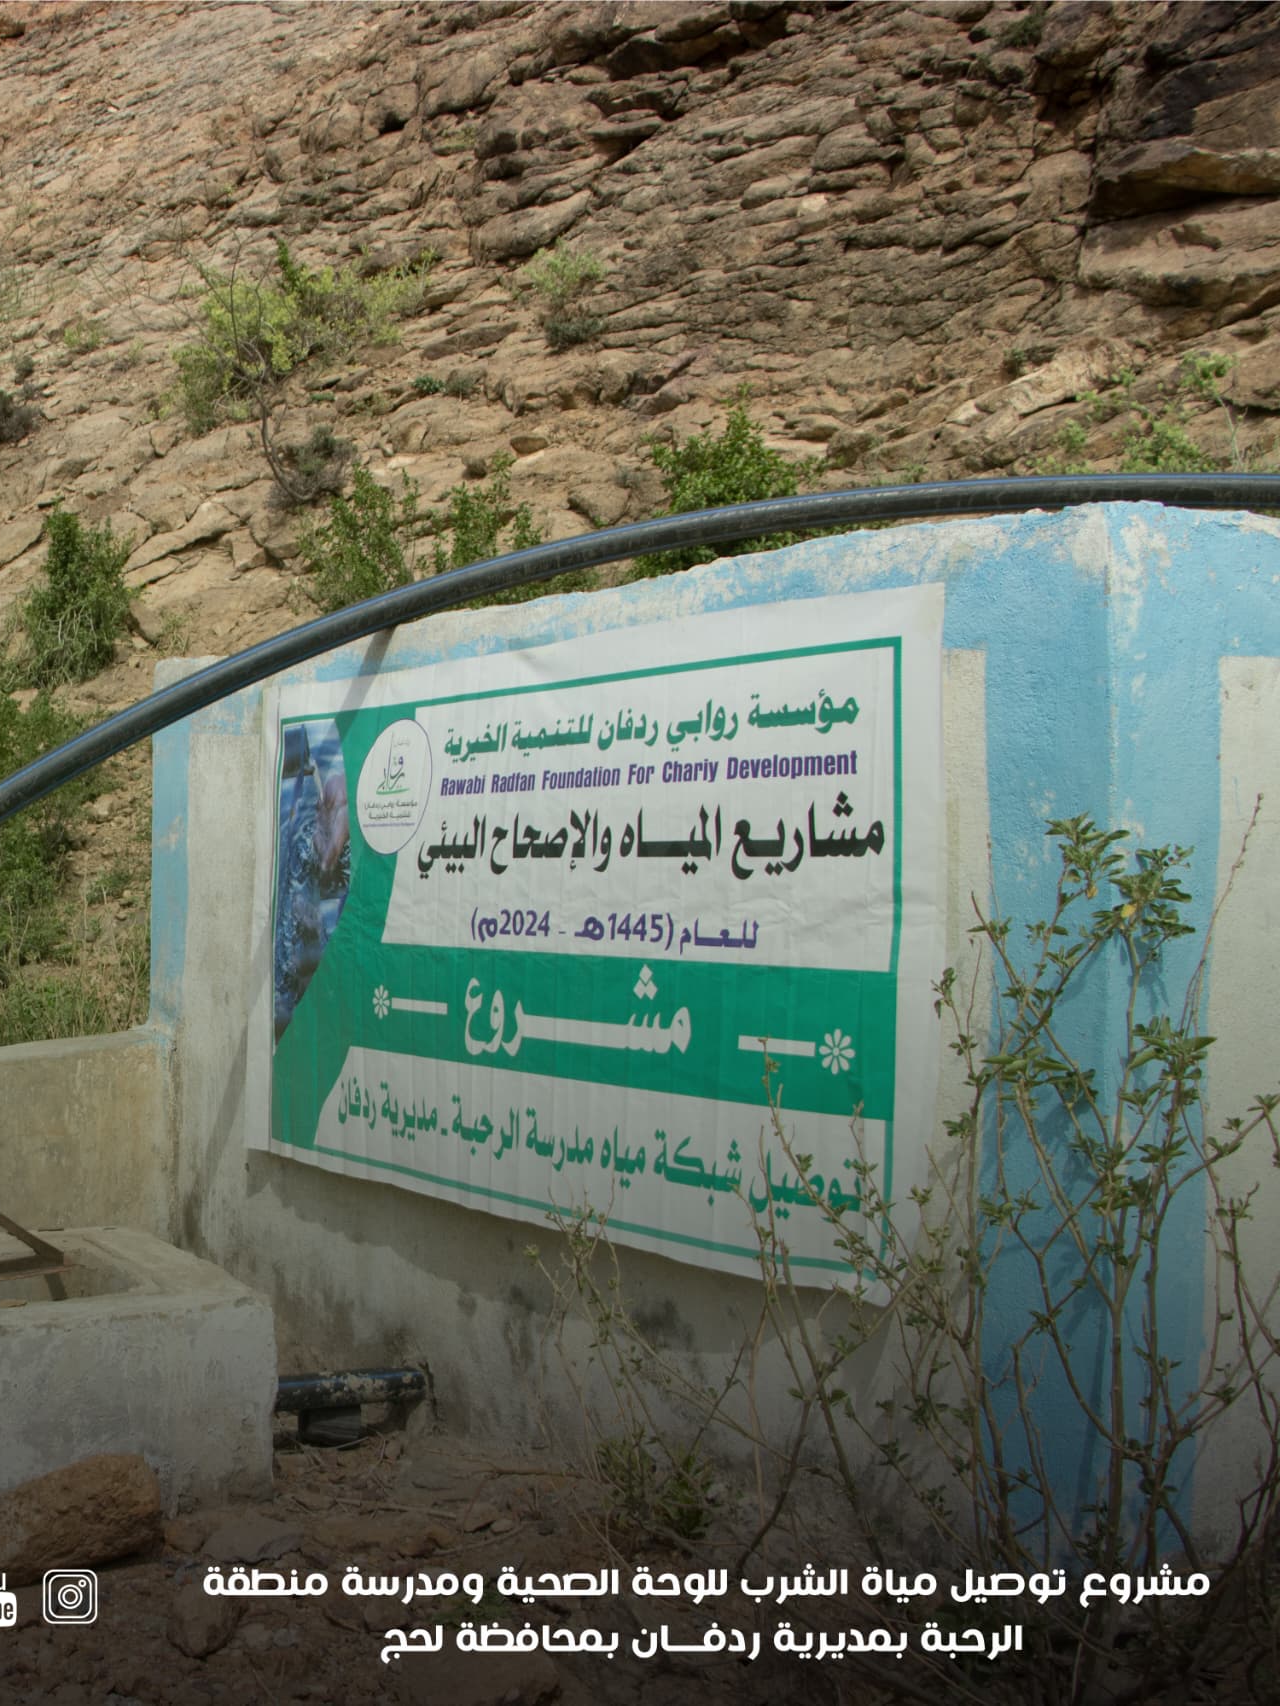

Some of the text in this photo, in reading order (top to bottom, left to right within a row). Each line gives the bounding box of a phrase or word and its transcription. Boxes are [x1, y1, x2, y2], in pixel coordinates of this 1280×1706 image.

[445, 689, 859, 762] مؤسسة روابي ردفان للتنمية الخيرية
[441, 751, 857, 796] Rawabi Radfan Foundation For Chariy Development
[418, 816, 486, 879] البيئي
[491, 810, 612, 874] والإصحاح
[732, 792, 885, 880] مشاريع
[680, 919, 759, 954] للعام
[465, 965, 691, 1056] مشروع
[337, 1074, 376, 1129] ردفان
[381, 1083, 437, 1140] مديرية
[452, 1096, 519, 1160] الرحبة
[526, 1108, 593, 1171] مدرسة
[601, 1128, 645, 1188] مياه
[654, 1130, 741, 1205] شبكة
